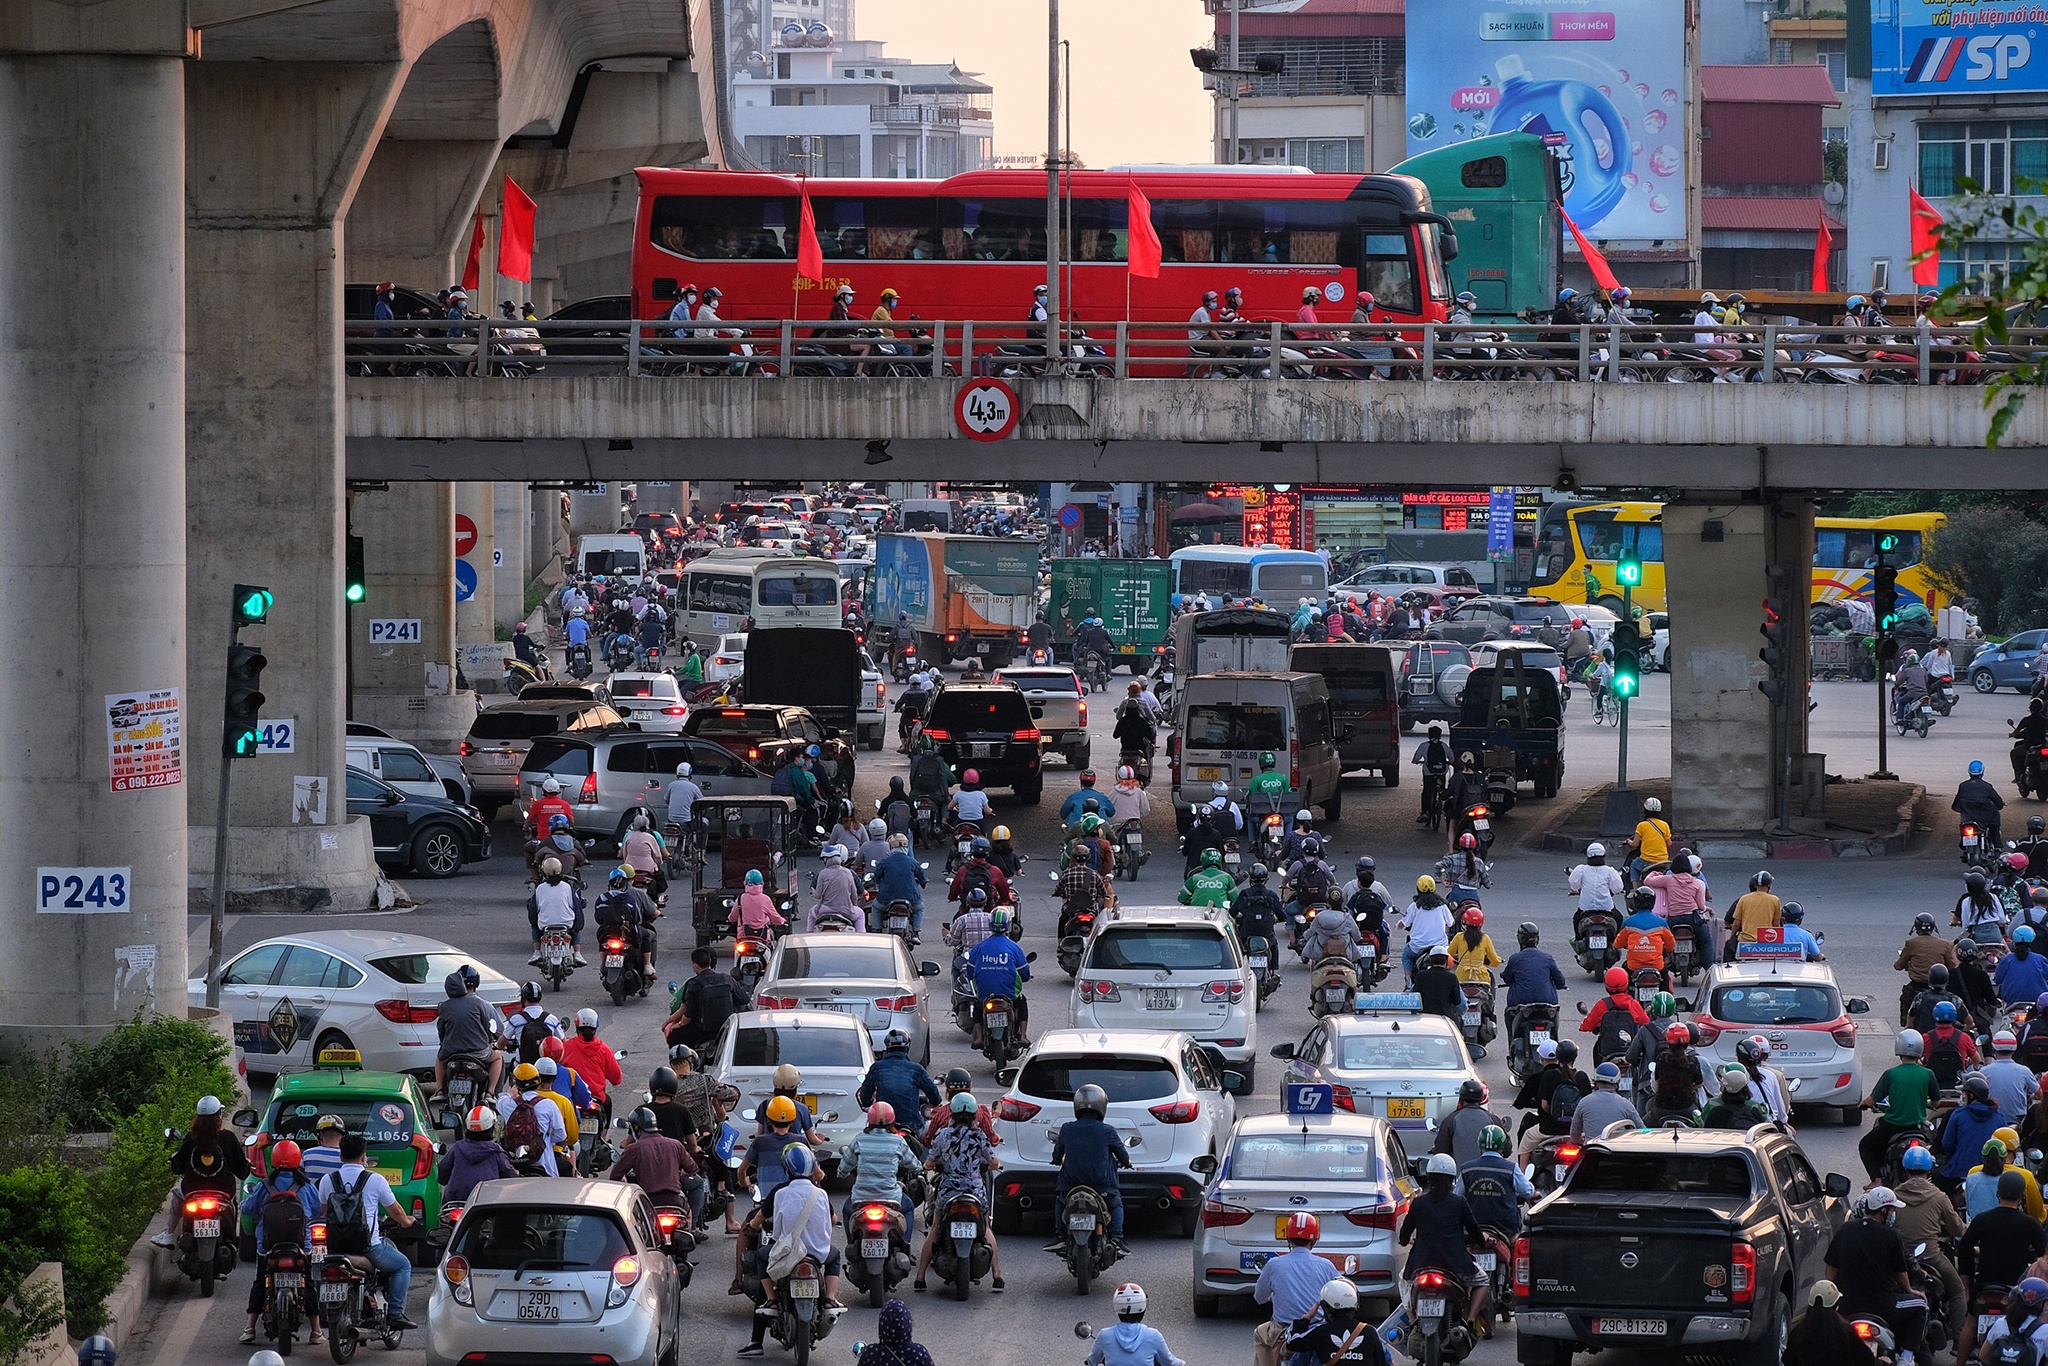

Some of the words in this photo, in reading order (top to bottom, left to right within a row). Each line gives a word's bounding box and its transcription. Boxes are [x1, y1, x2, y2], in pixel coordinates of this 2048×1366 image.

[1932, 9, 1951, 25] với
[1952, 9, 1976, 29] phụ
[1979, 9, 2005, 28] kiện
[2006, 5, 2027, 23] nối
[1966, 35, 2031, 82] SP
[1461, 90, 1490, 105] MỚI
[1274, 496, 1289, 504] SỬA
[1516, 512, 1537, 520] TOÀN
[371, 621, 419, 640] P241
[261, 724, 291, 749] 42
[1261, 779, 1282, 788] Grab
[1197, 879, 1223, 889] Grab
[41, 873, 127, 909] P243
[1153, 989, 1169, 999] 30A
[1147, 999, 1174, 1008] 413.74
[273, 1014, 294, 1027] GREEN
[1398, 1099, 1415, 1108] 30E
[1392, 1108, 1422, 1117] 177.80
[377, 1130, 410, 1142] 1055
[1480, 1182, 1493, 1190] 44
[1537, 1285, 1576, 1293] NAVARA
[528, 1292, 551, 1305] 29D
[519, 1306, 559, 1319] 054.70
[1601, 1320, 1665, 1333] 29C-813.26
